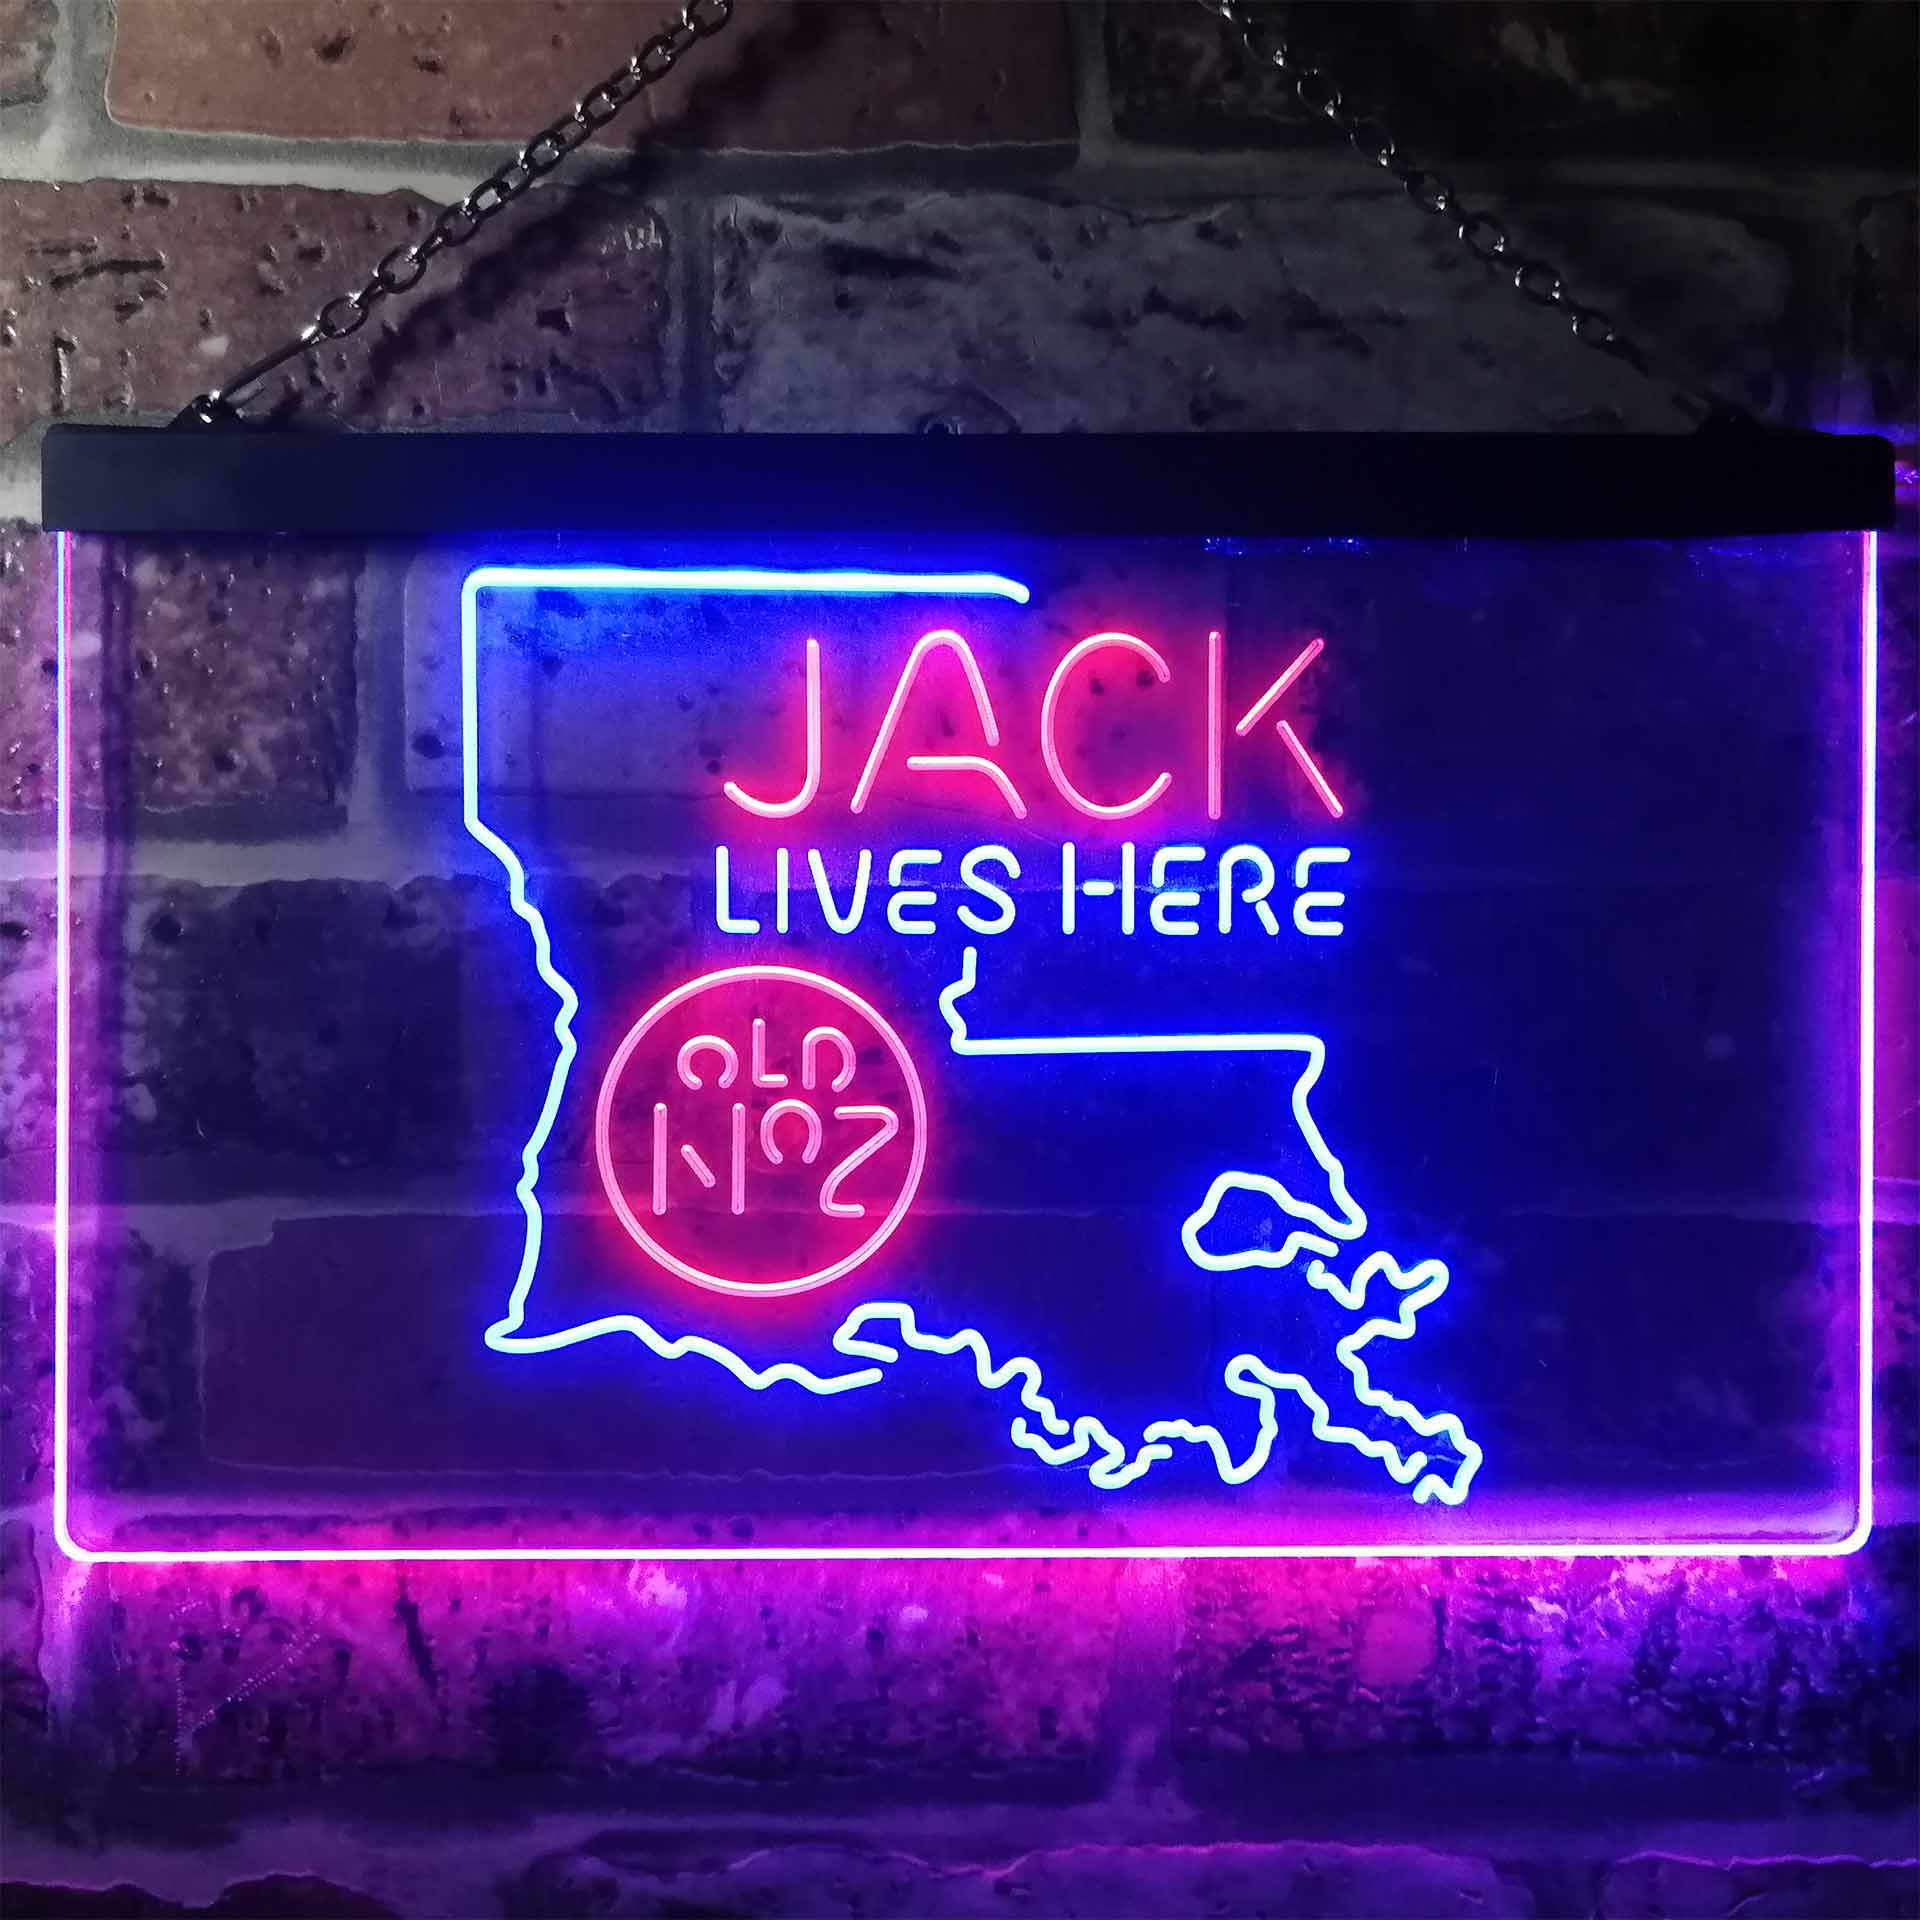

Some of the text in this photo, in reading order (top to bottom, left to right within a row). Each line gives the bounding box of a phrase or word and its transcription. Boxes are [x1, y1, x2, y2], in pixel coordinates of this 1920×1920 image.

[724, 629, 1344, 819] JACK
[715, 841, 1351, 935] LIVES HERE
[676, 1018, 857, 1092] OLD
